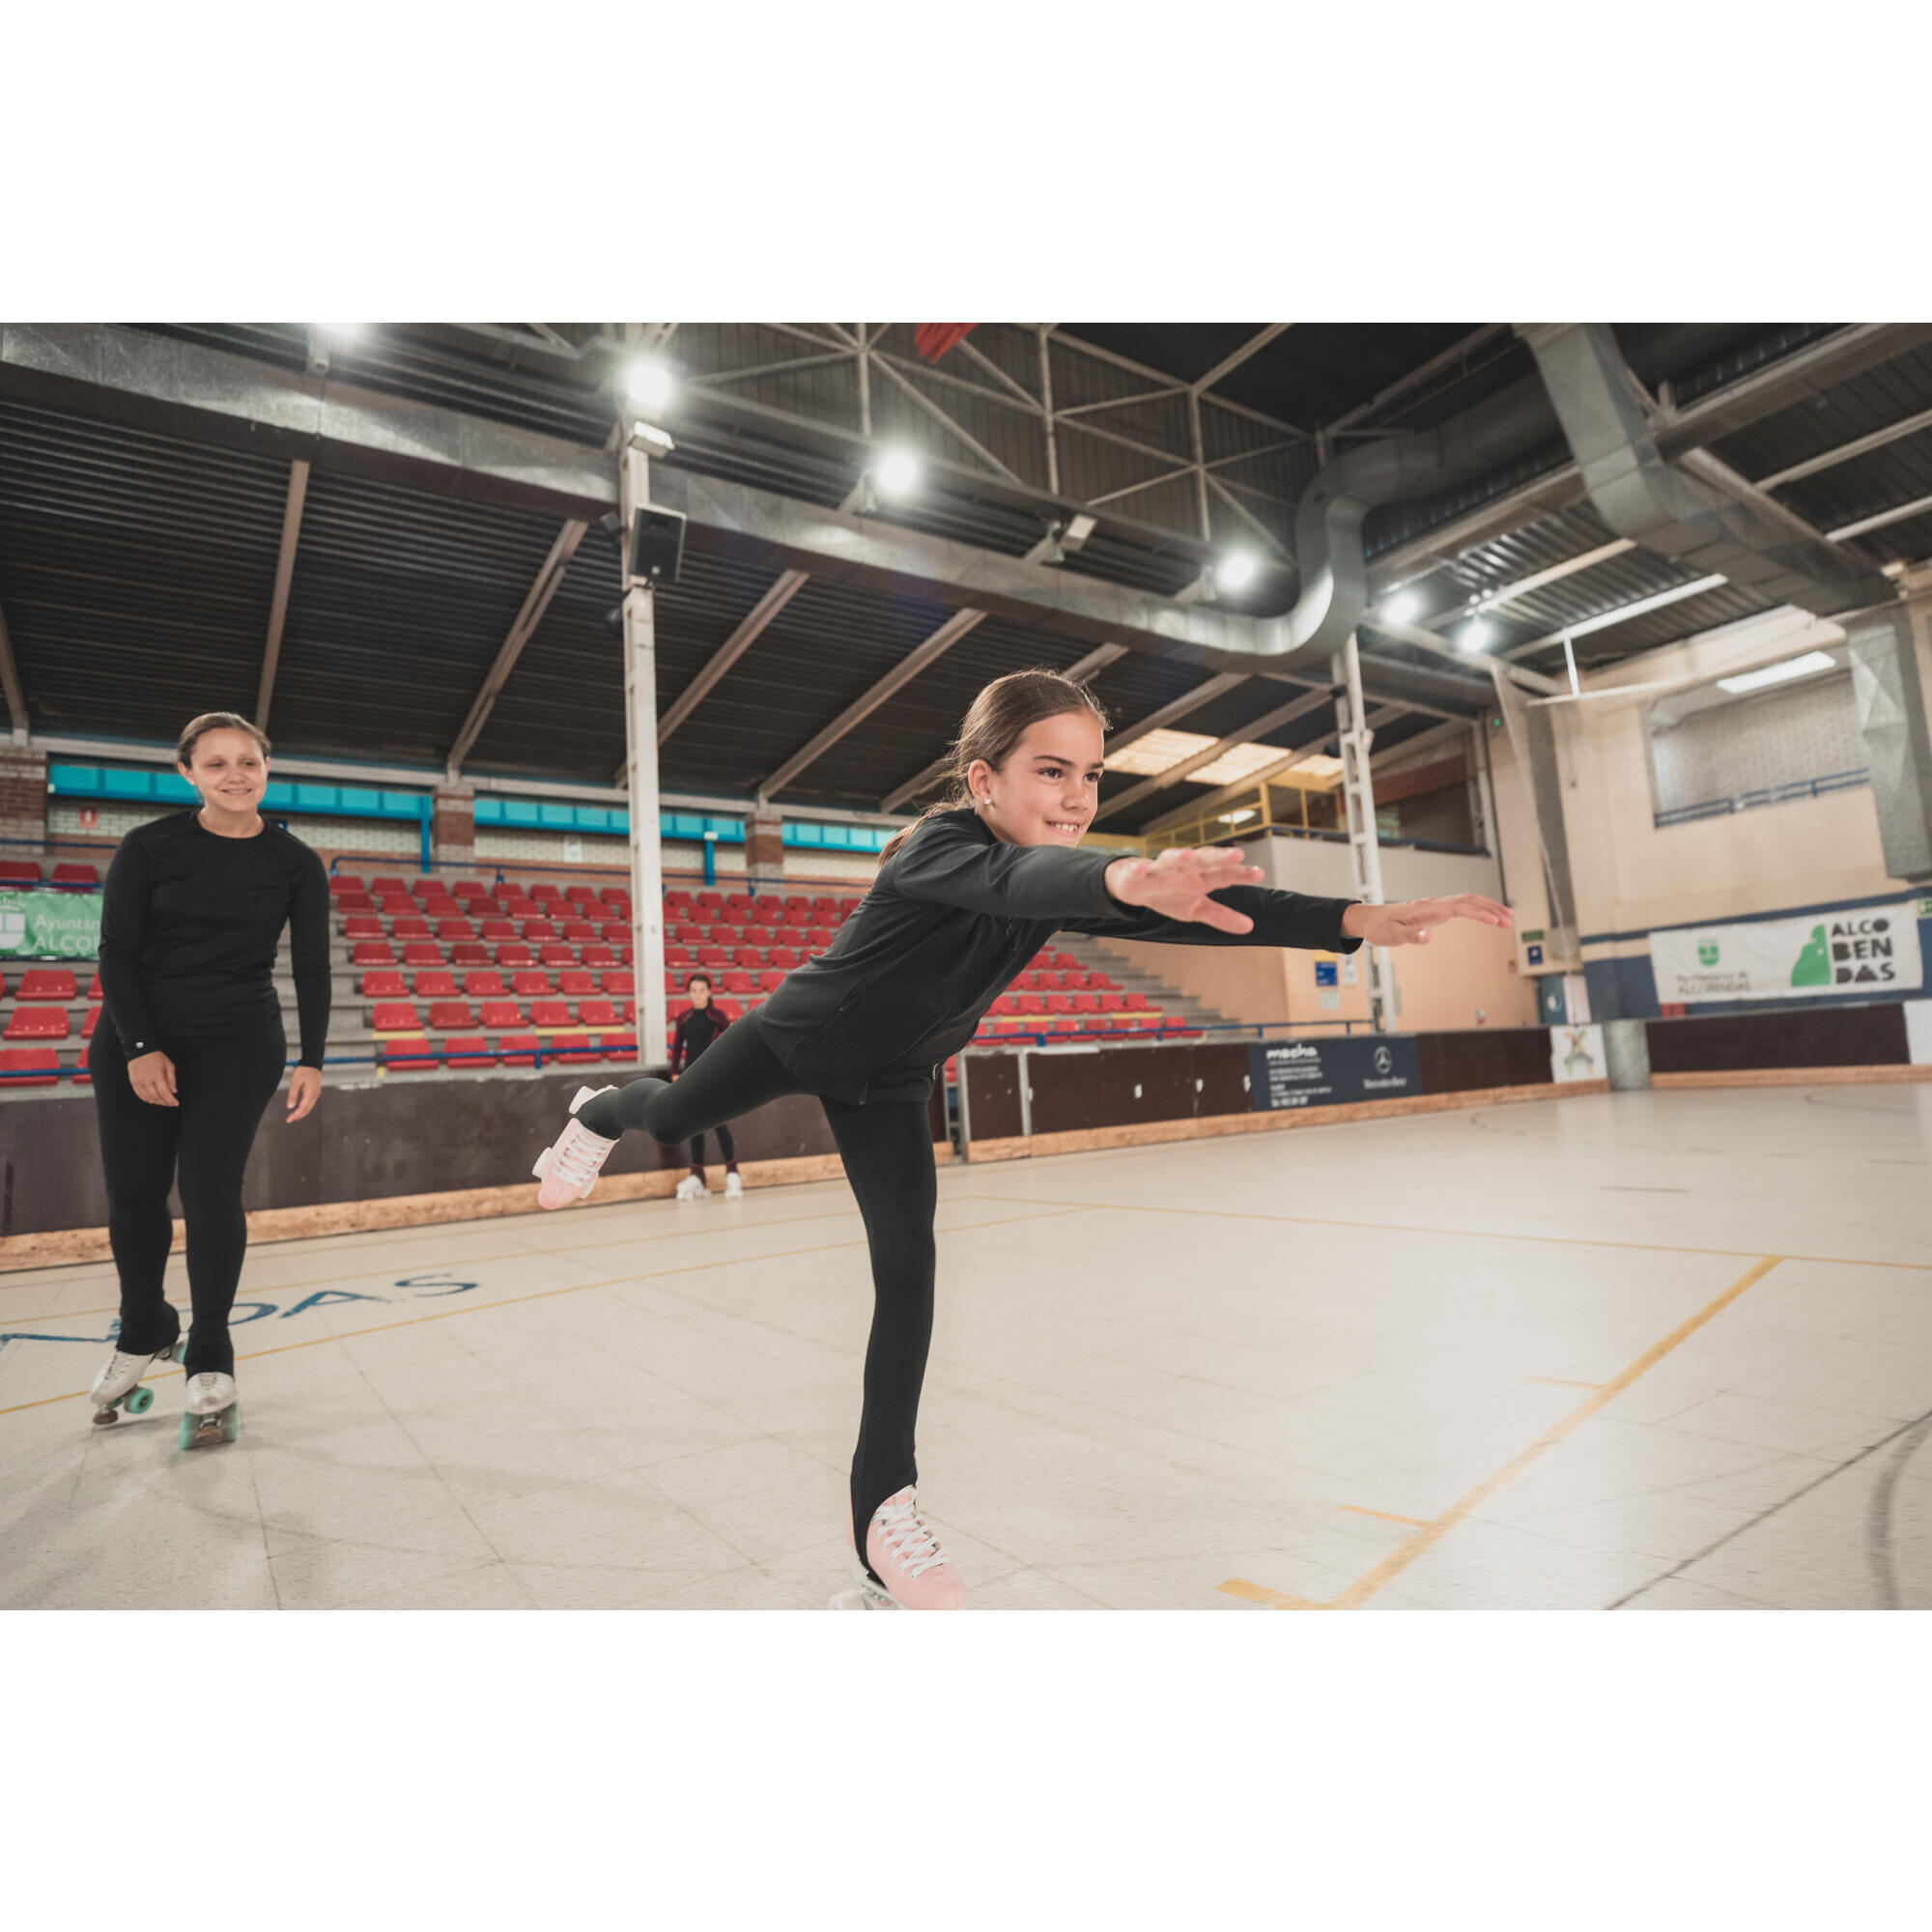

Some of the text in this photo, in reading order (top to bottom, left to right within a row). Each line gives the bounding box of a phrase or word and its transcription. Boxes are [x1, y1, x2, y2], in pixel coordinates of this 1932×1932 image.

[1832, 919, 1889, 937] ALCO
[1832, 938, 1893, 962] BEN
[1835, 962, 1895, 985] DAS
